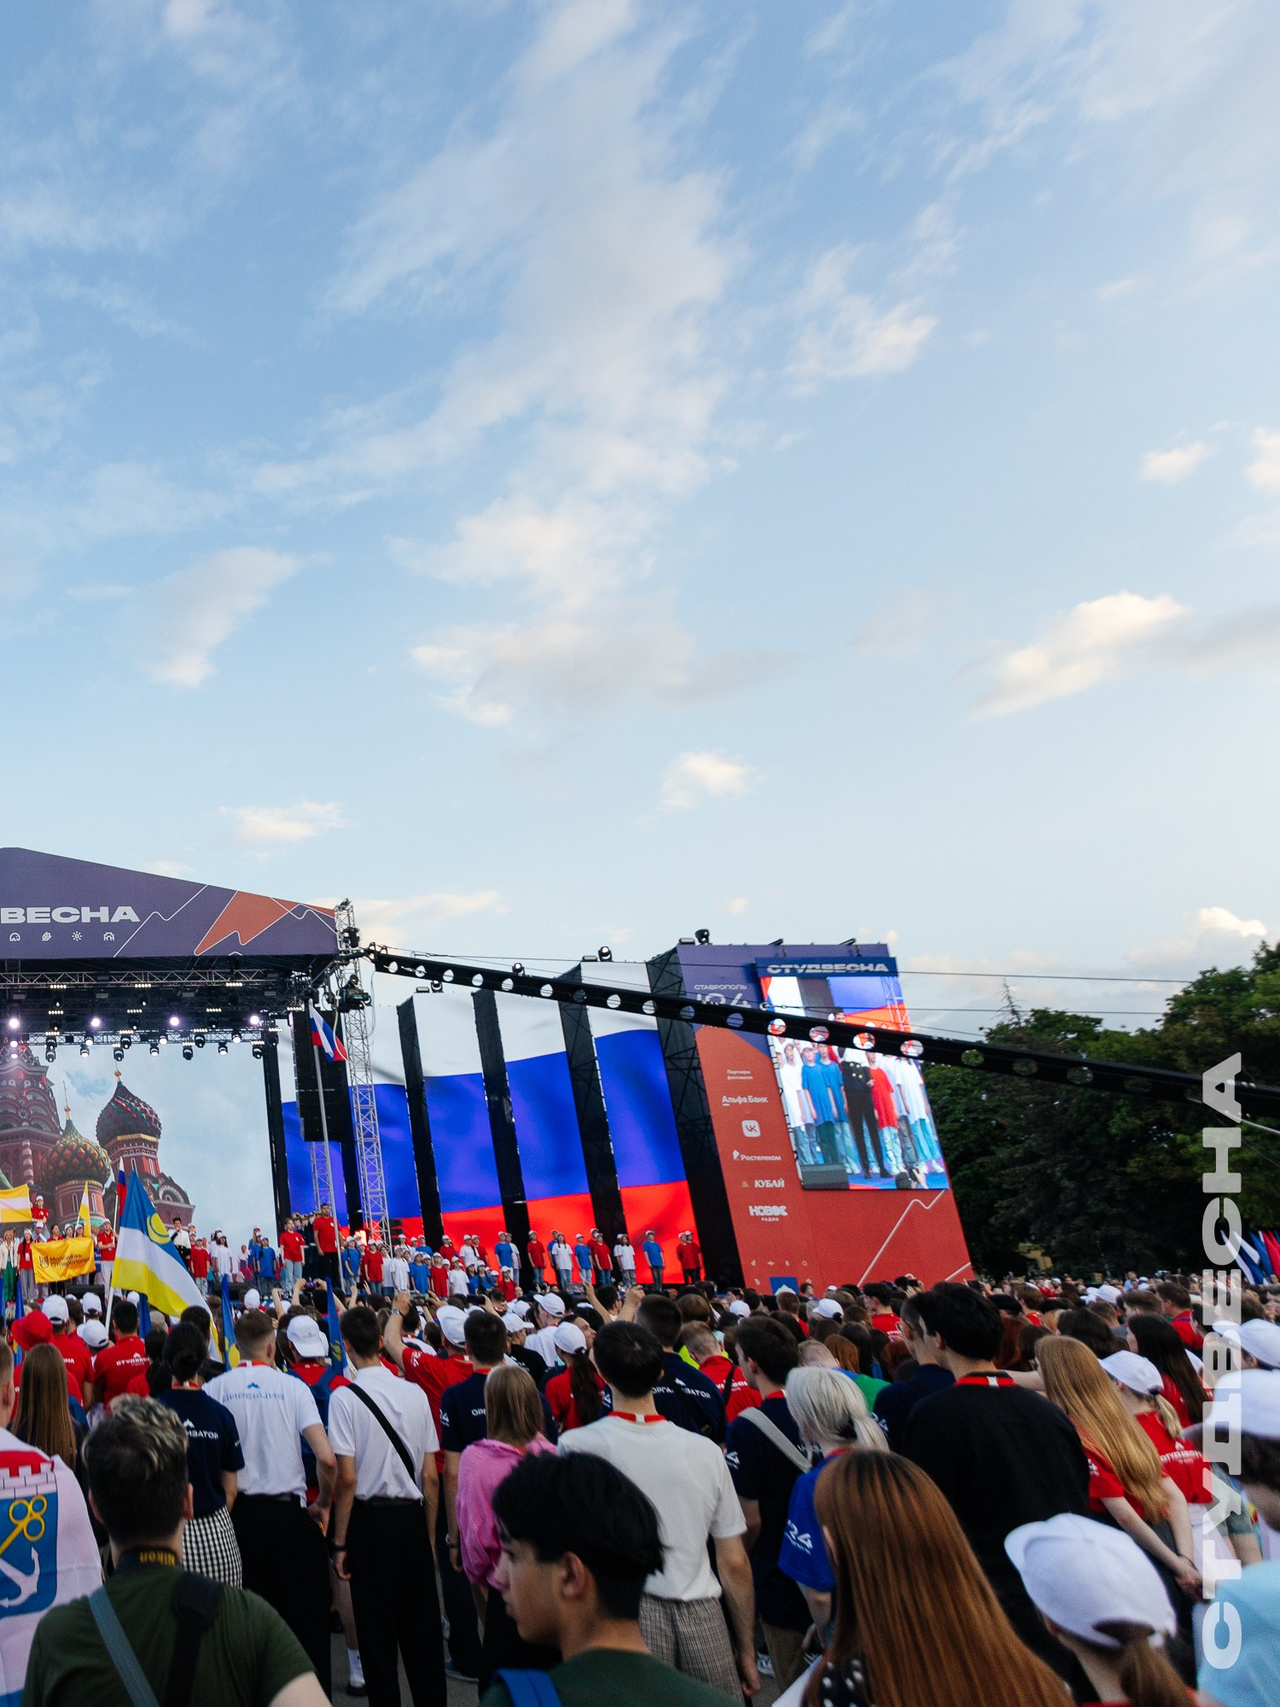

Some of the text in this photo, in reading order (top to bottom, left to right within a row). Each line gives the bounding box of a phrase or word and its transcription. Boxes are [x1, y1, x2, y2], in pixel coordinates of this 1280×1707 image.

[766, 962, 890, 974] СТУДВЕСНА
[740, 1153, 782, 1161] Ростелеком
[754, 1177, 786, 1188] КУБАЙ
[140, 1551, 175, 1568] Nikon
